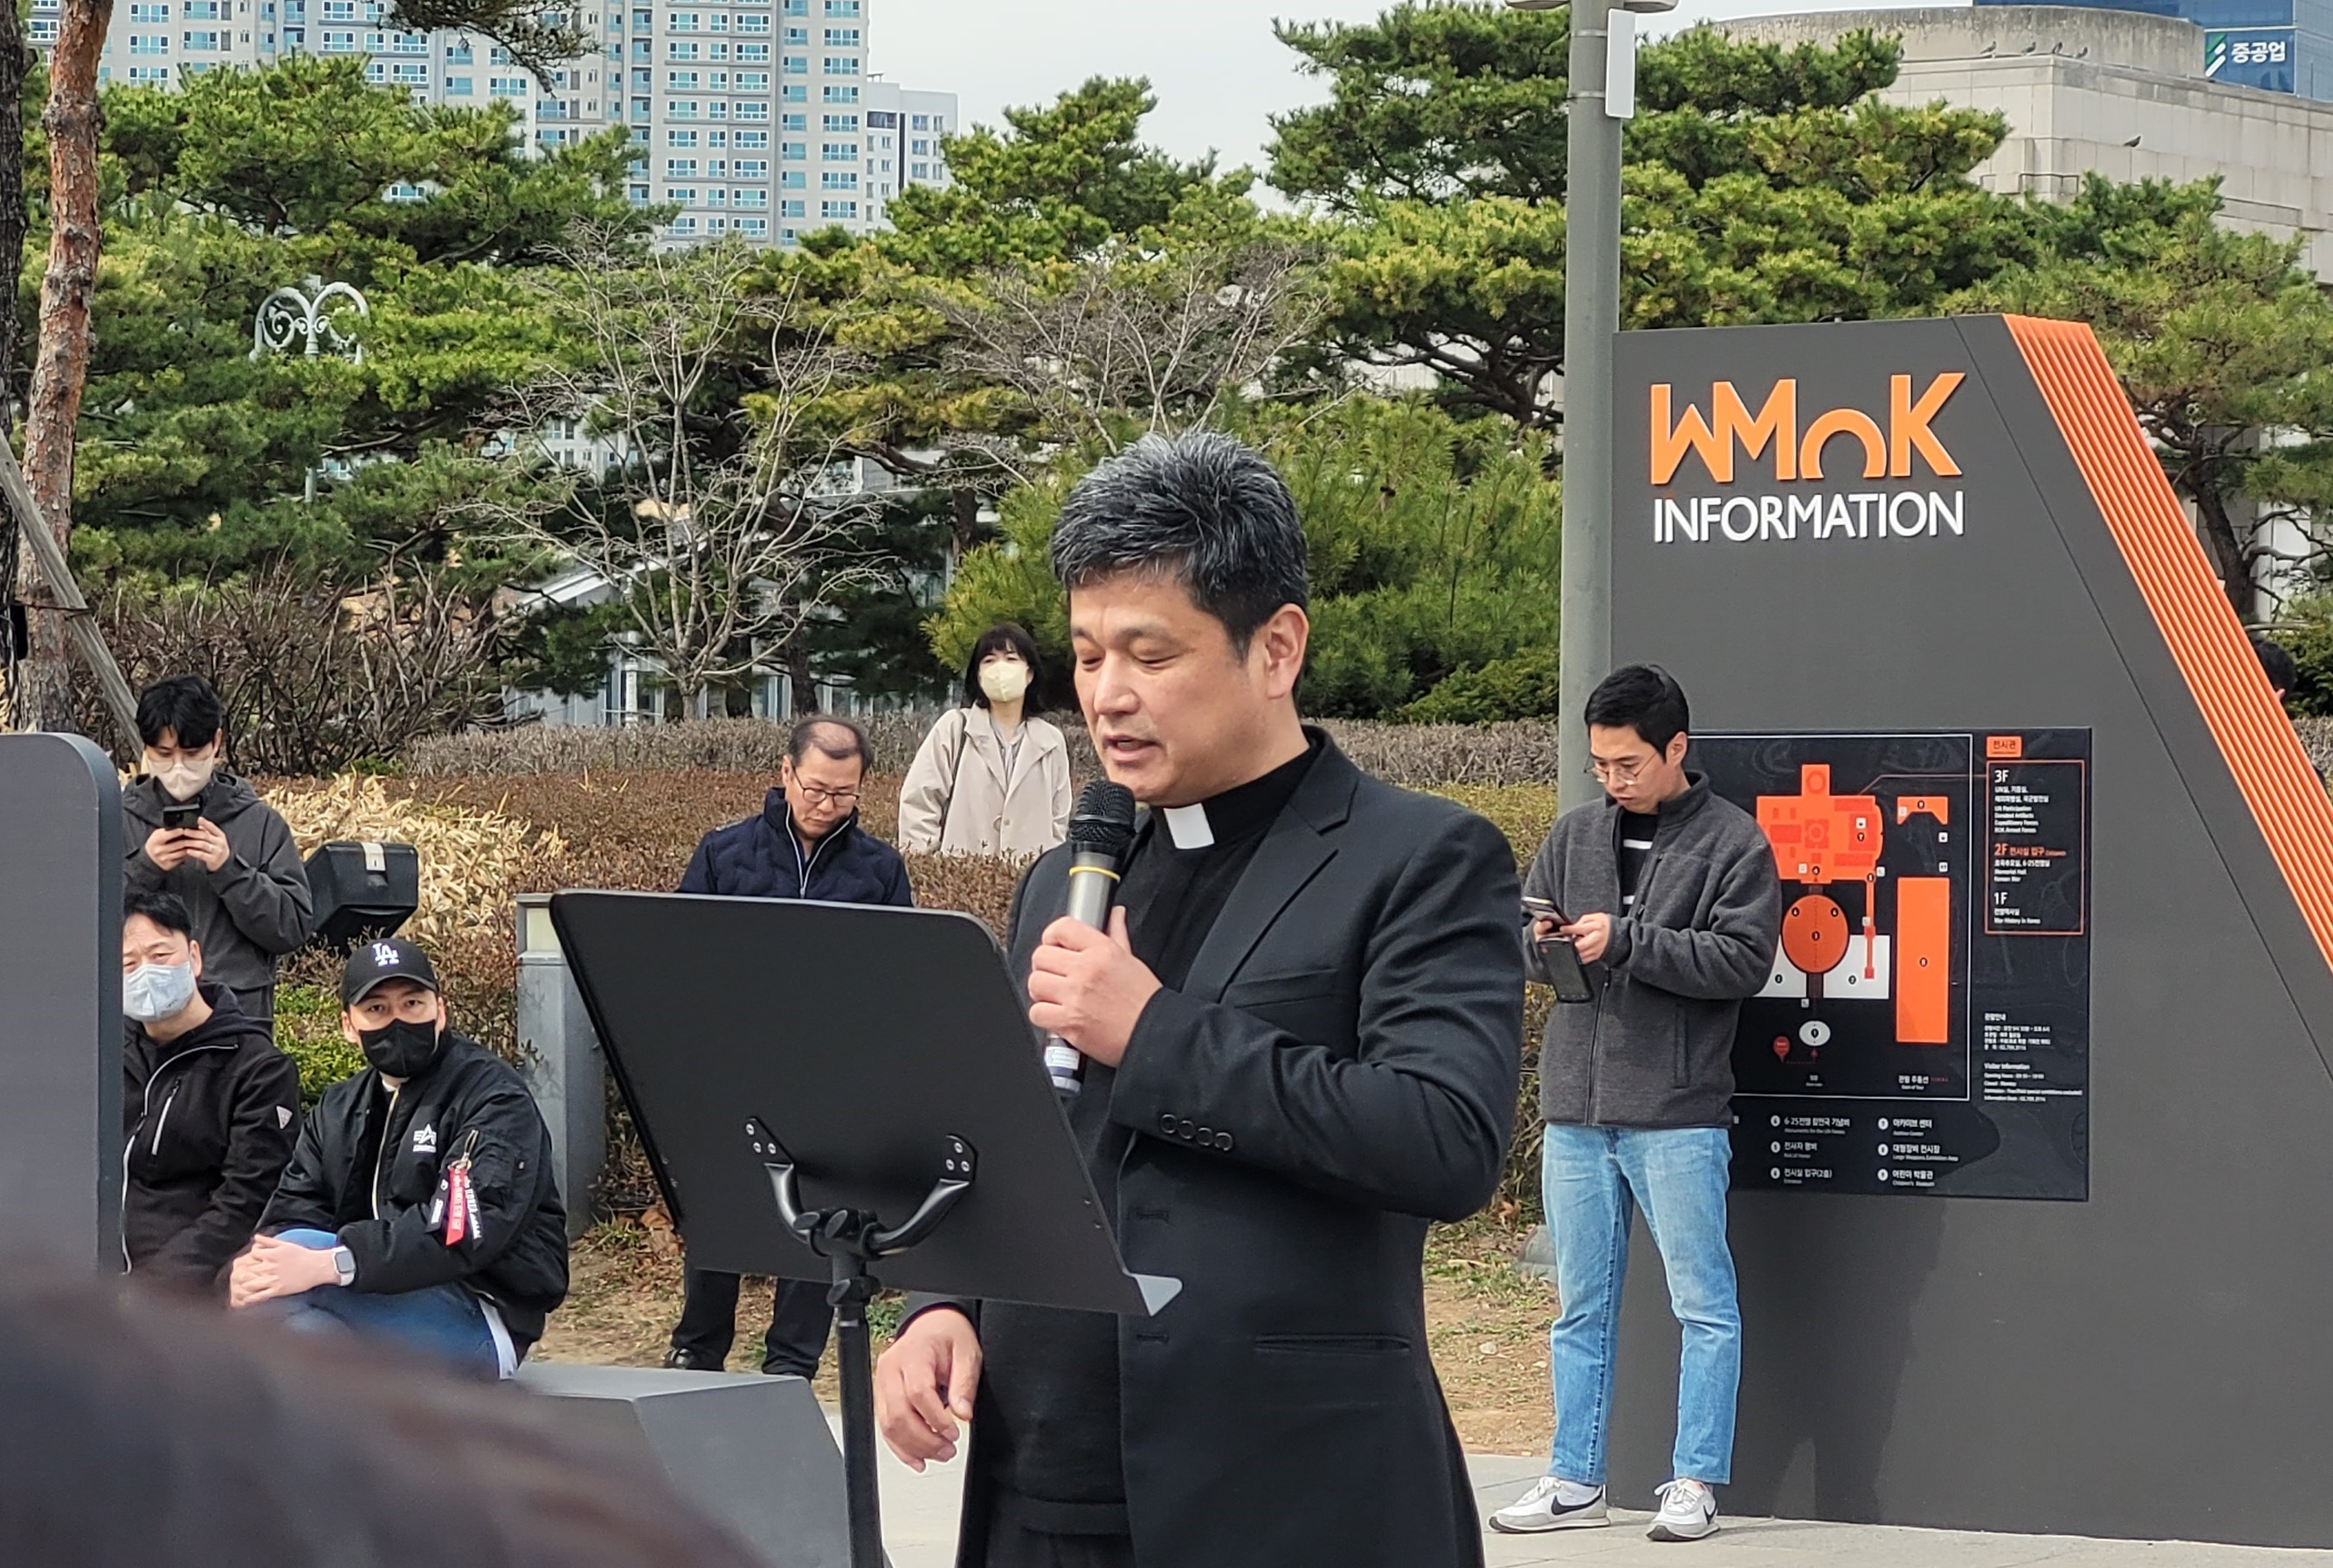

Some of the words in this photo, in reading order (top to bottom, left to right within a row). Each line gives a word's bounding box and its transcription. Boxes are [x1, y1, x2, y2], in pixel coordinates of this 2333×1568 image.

[2231, 41, 2286, 63] 중공업
[1653, 490, 1965, 543] INFORMATION
[1995, 769, 2009, 783] 3F
[1995, 843, 2008, 856] 2F
[1994, 892, 2008, 905] 1F
[372, 942, 400, 967] LA
